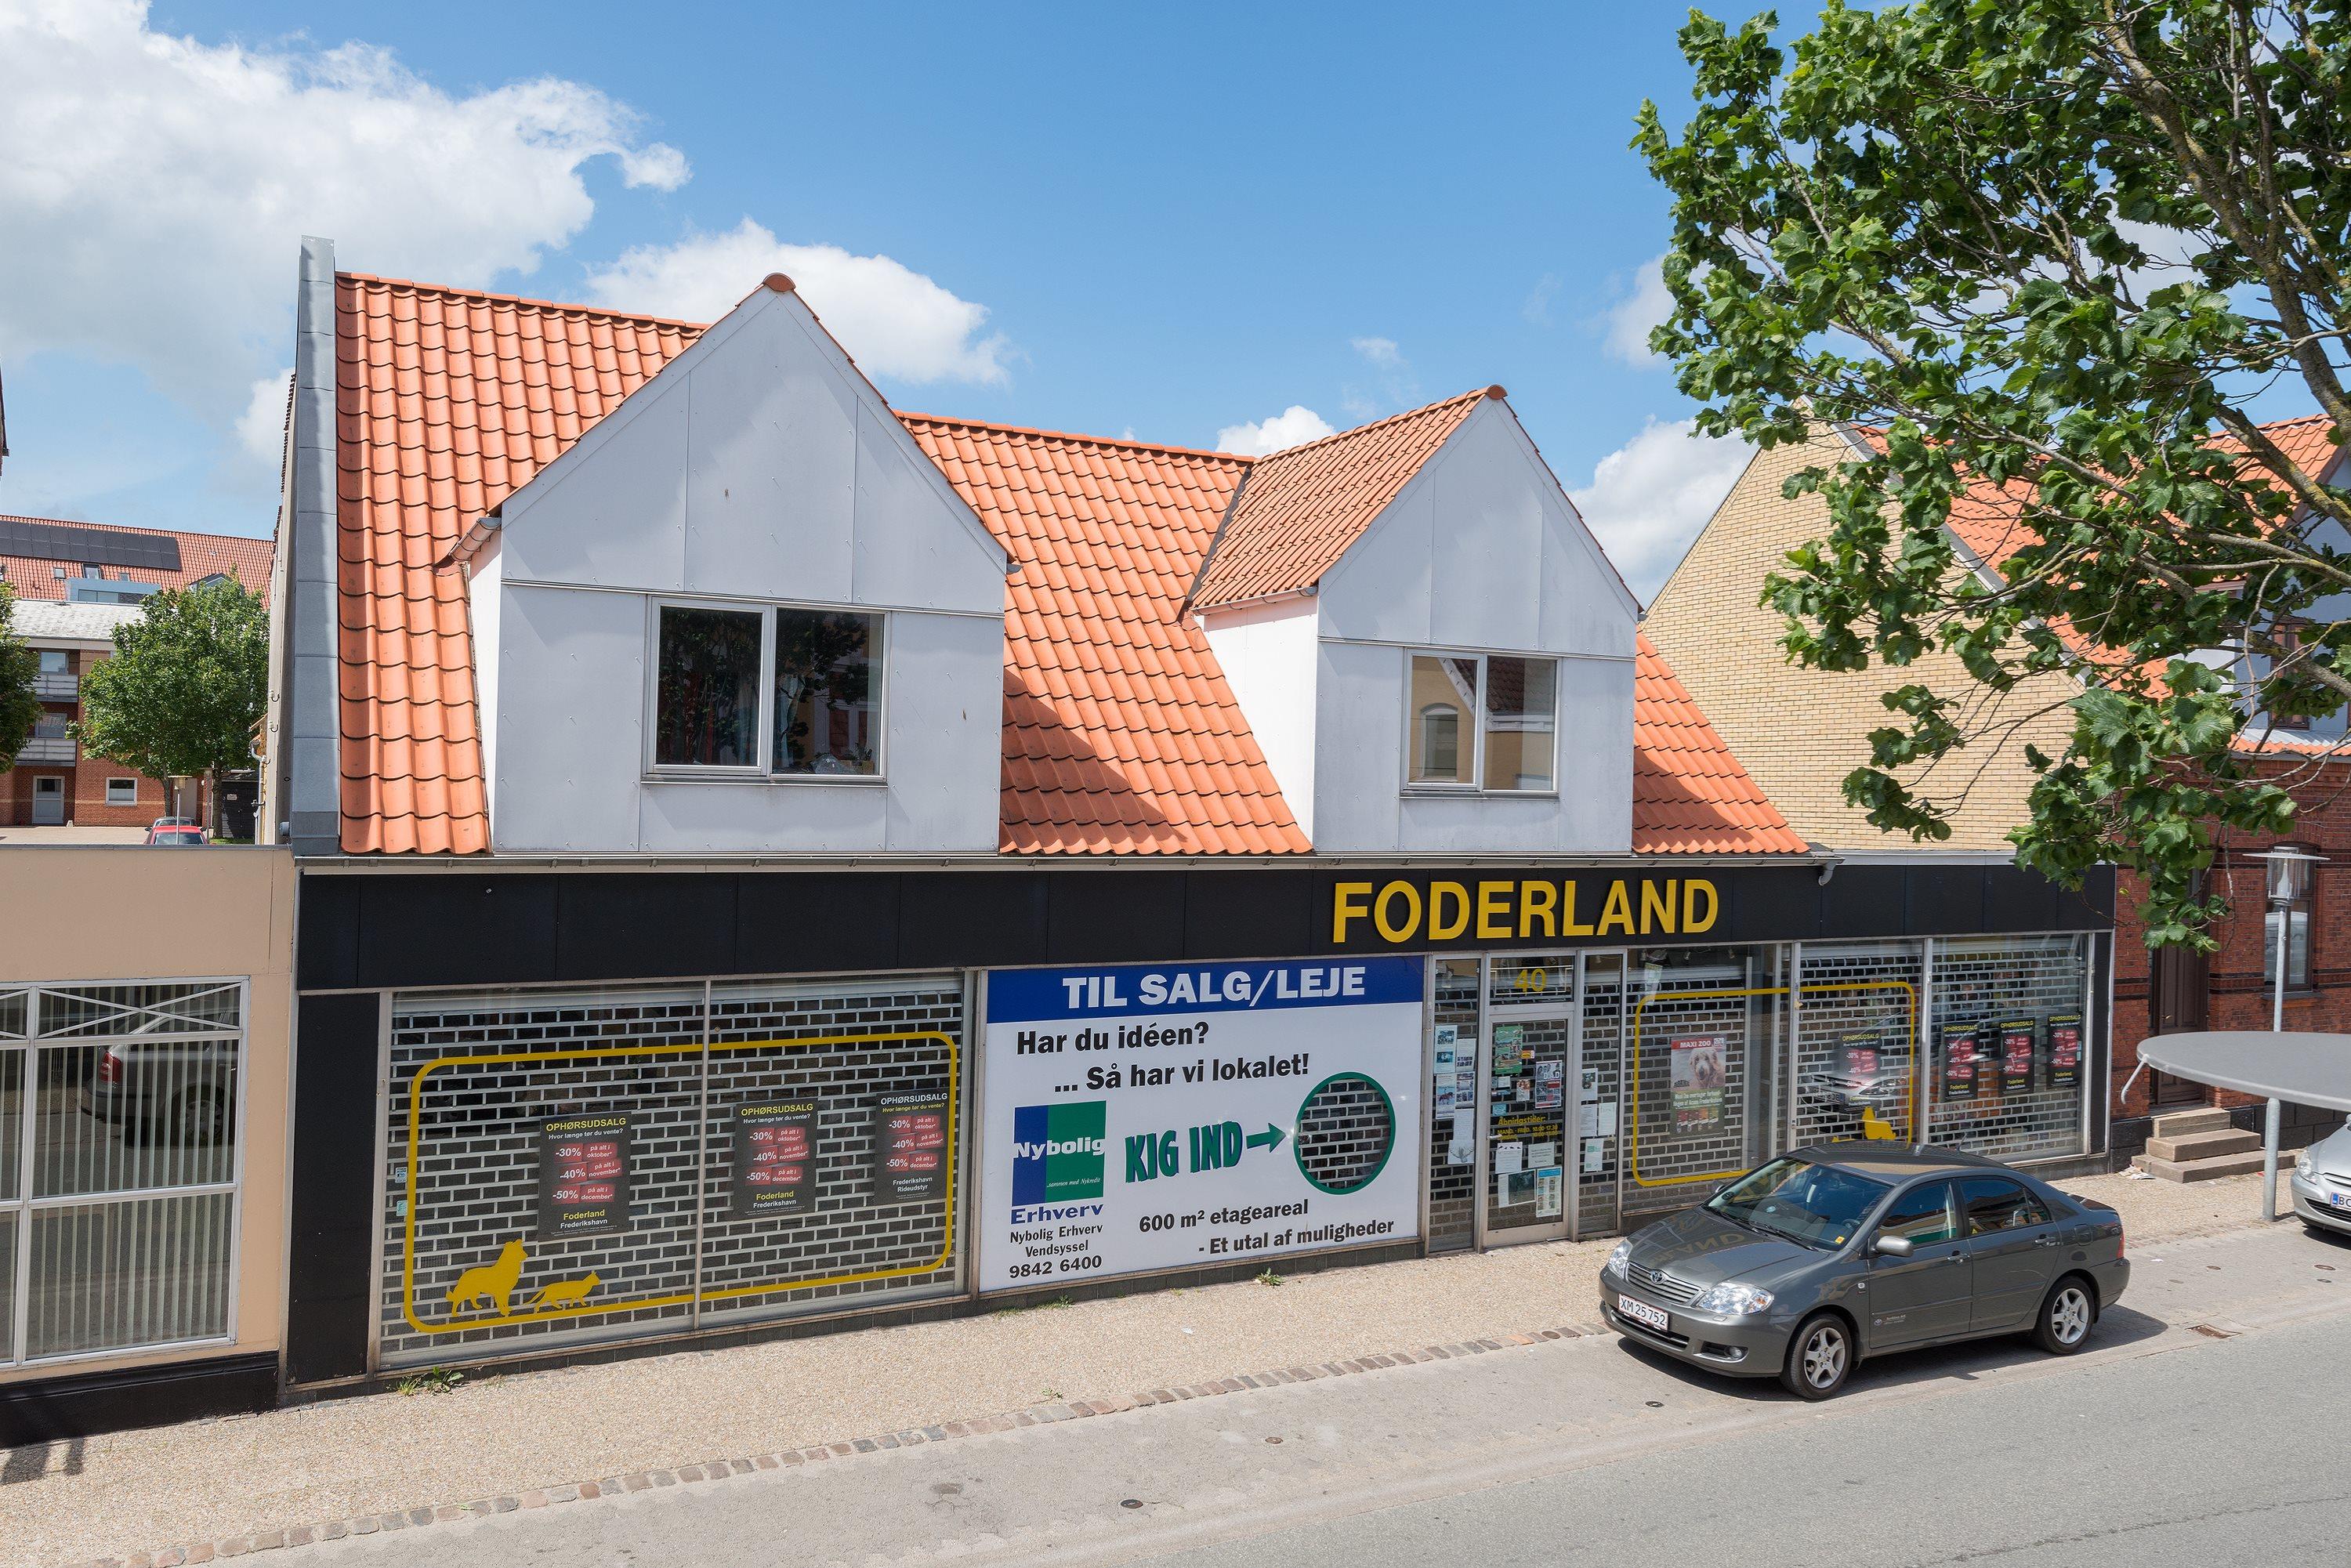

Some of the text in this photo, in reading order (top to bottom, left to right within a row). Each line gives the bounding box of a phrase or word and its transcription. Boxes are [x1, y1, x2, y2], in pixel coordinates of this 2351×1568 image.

[1333, 879, 1719, 943] FODERLAND
[1063, 967, 1365, 1009] TIL SALG/LEJE
[1514, 968, 1546, 994] 40
[1017, 1022, 1209, 1055] Har du idéen?
[1054, 1053, 1309, 1092] ... Så har vi lokalet!
[881, 1093, 947, 1105] OPHØRSUDSALG
[741, 1103, 813, 1116] OPHØRSUDSALG
[546, 1118, 626, 1131] OPHØRSUDSALG
[749, 1132, 773, 1140] -30%
[893, 1139, 914, 1148] -40%
[556, 1147, 581, 1157] -30%
[753, 1151, 777, 1161] -40%
[1012, 1137, 1106, 1160] Nybolig
[1125, 1121, 1243, 1182] KIG IND
[560, 1168, 585, 1179] -40%
[747, 1172, 770, 1181] -50%
[552, 1190, 578, 1199] -50%
[756, 1190, 794, 1200] Foderland
[754, 1200, 796, 1208] Frederikshavn
[563, 1209, 605, 1220] Foderland
[1011, 1204, 1103, 1224] Erhverv
[1139, 1200, 1309, 1233] 600 m² etageareal
[560, 1219, 607, 1229] Frederikshavn
[1010, 1225, 1103, 1244] Nybolig Erhverv
[1210, 1237, 1229, 1254] Et
[1233, 1232, 1268, 1251] utal
[1273, 1229, 1292, 1248] af
[1298, 1219, 1394, 1246] muligheder
[1026, 1240, 1088, 1257] Vendsyssel
[1009, 1255, 1102, 1278] 9842 6400
[1621, 1298, 1665, 1325] XM 25 752
